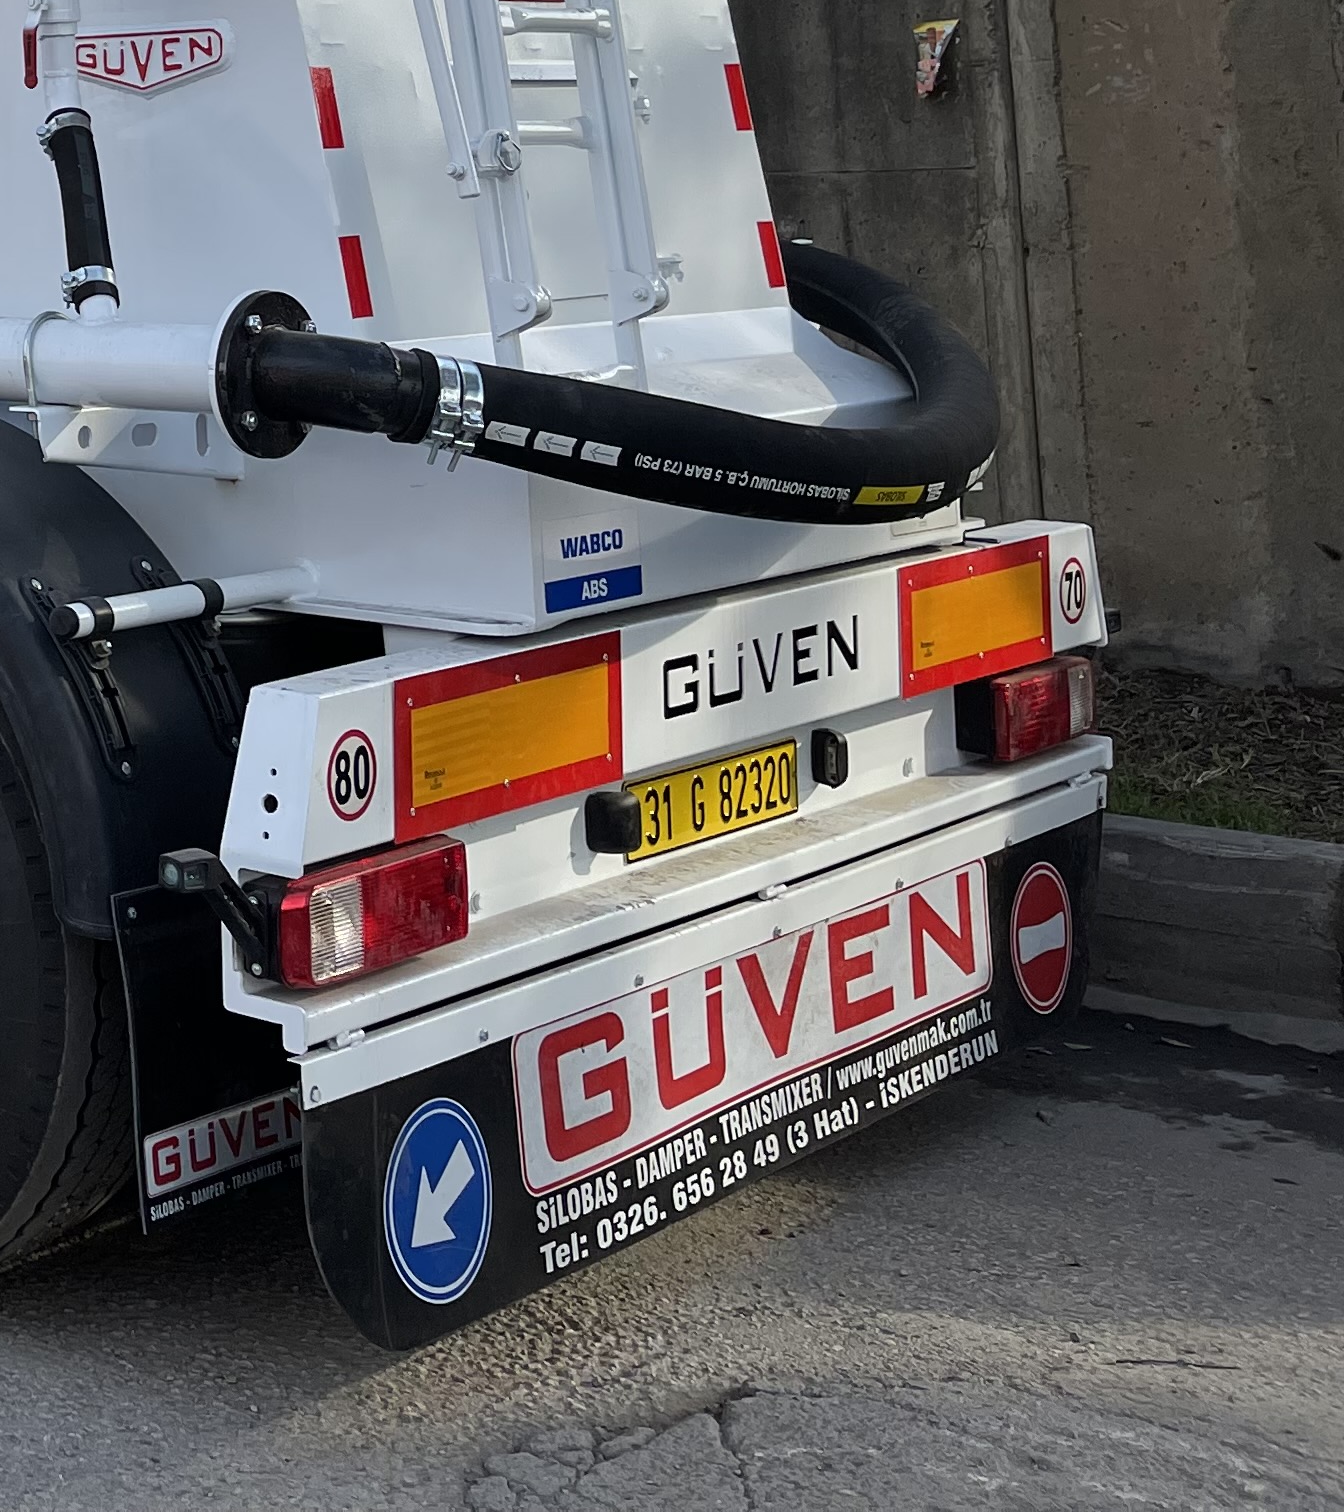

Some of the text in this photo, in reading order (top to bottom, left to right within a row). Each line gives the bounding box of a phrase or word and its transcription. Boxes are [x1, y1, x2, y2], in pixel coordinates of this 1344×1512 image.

[75, 35, 213, 82] GÜVEN
[634, 453, 662, 472] PSI)
[664, 459, 683, 477] (73
[684, 463, 713, 481] BAR
[715, 468, 724, 482] 5
[751, 475, 807, 496] HORTUMU
[560, 528, 623, 559] WABCO
[581, 577, 608, 601] ABS
[1064, 569, 1083, 611] 70
[663, 614, 858, 720] GÜVEN
[335, 744, 370, 805] 80
[645, 752, 791, 845] 31 G 82320
[538, 872, 976, 1162] GÜVEN
[636, 1127, 707, 1189] DAMPER
[719, 1073, 824, 1145] TRANSMIXER
[835, 998, 993, 1090] www.guvenmak.com.tr
[152, 1096, 302, 1186] GÜVEN
[191, 1181, 226, 1206] DAMPER
[232, 1160, 283, 1190] TRANSMIXER
[539, 1232, 590, 1274] Tel:
[596, 1195, 667, 1250] 0326.
[672, 1168, 716, 1212] 656
[719, 1150, 747, 1188] 28
[753, 1133, 780, 1168] 49
[786, 1120, 809, 1154] (3
[813, 1097, 859, 1140] Hat)
